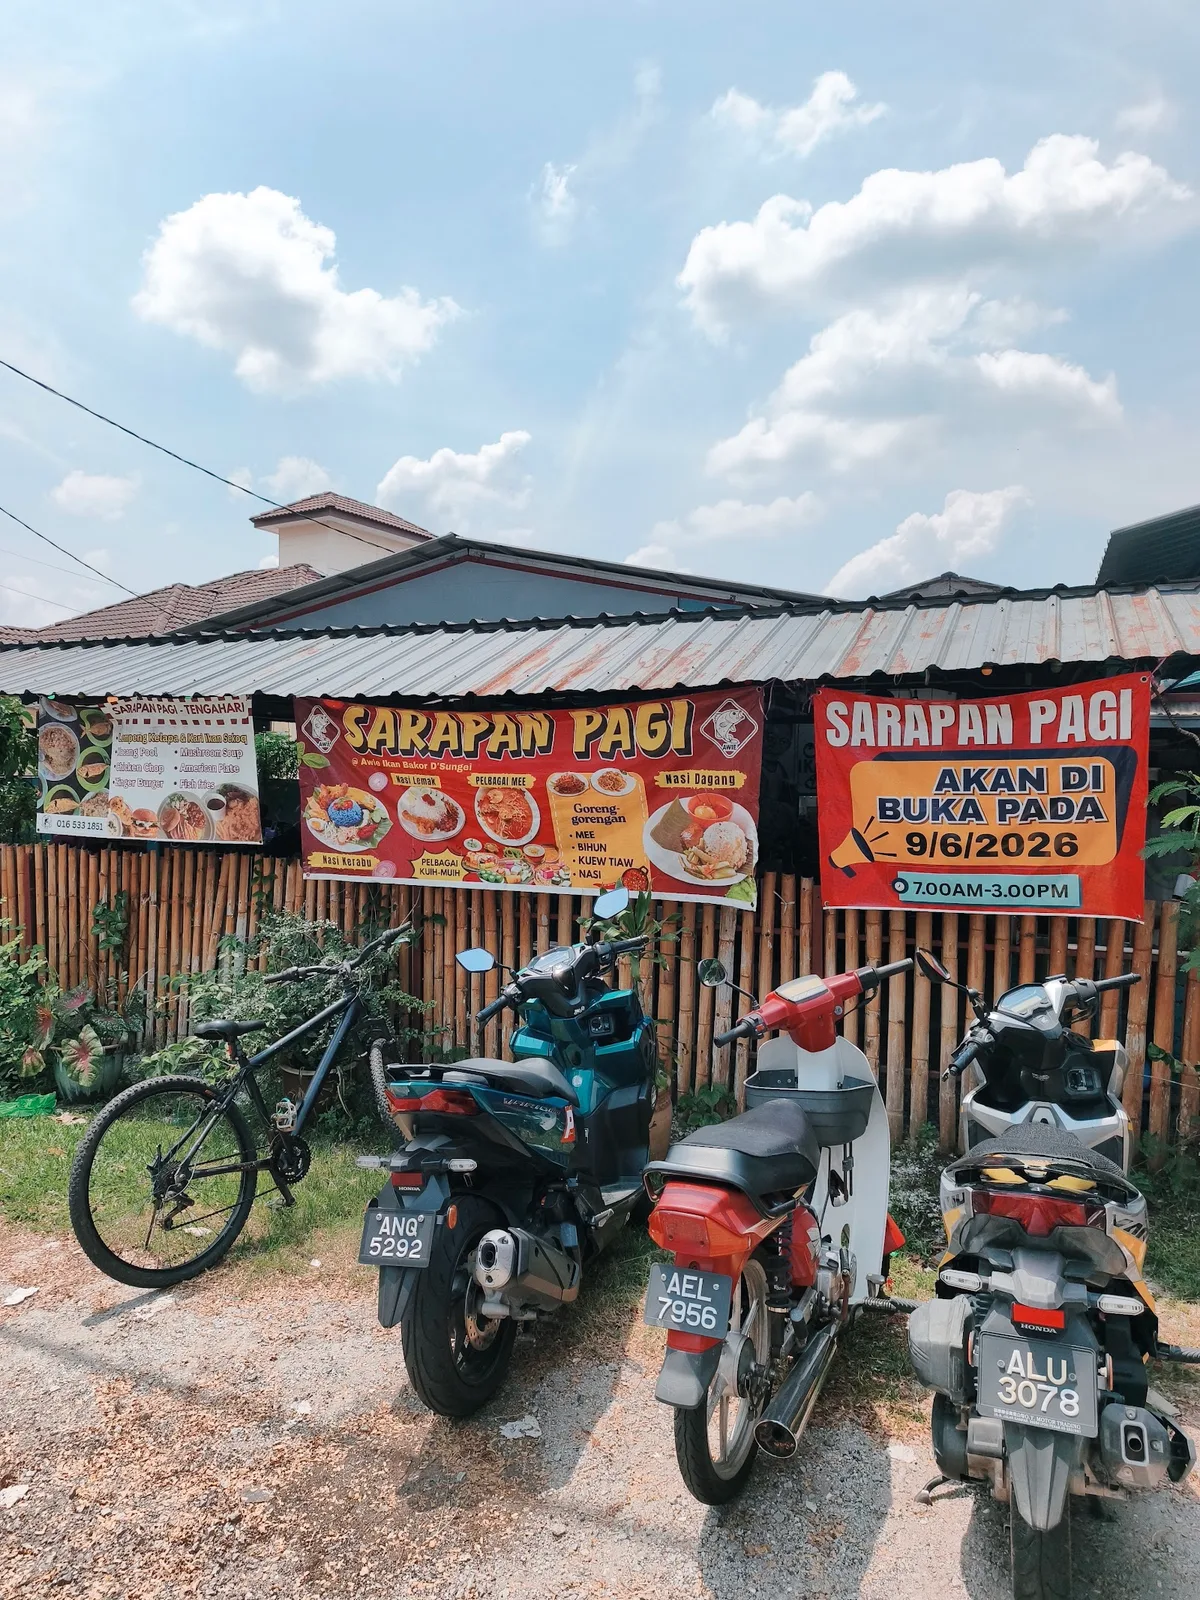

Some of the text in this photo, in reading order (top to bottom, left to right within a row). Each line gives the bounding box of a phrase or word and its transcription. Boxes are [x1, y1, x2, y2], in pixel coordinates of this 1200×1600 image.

[112, 702, 157, 715] SARAPAN
[157, 705, 178, 715] PAGI
[184, 702, 245, 715] TENGAHARI
[826, 688, 1132, 747] SARAPAN PAGI
[342, 699, 695, 761] SARAPAN PAGI
[148, 732, 179, 745] Kelapa
[180, 733, 187, 743] &
[187, 733, 204, 743] Kari
[139, 746, 158, 758] Pool
[180, 746, 243, 760] Mushroom Soup
[143, 762, 165, 774] Chop
[179, 763, 240, 774] American Plate
[351, 757, 359, 766] @
[360, 757, 381, 767] Awie
[382, 759, 401, 769] Ikan
[430, 762, 472, 773] D'Sungei
[137, 777, 165, 790] Burger
[179, 778, 215, 790] Fish fries
[395, 775, 437, 787] Nasi Lemak
[475, 776, 526, 786] PELBAGAI MEE
[665, 772, 736, 787] Nasi Dagang
[933, 764, 1106, 795] AKAN DI
[573, 803, 621, 815] Goreng-
[876, 796, 1109, 826] BUKA PADA
[56, 819, 103, 831] 016 533 1851
[571, 815, 627, 826] gorengan
[575, 830, 596, 839] MEE
[577, 842, 607, 853] BIHUN
[905, 831, 1079, 860] 9/6/2026
[322, 854, 372, 868] Nasi Kerabu
[421, 858, 459, 867] PELBAGAI
[578, 855, 634, 868] KUEW TIAW
[419, 867, 461, 877] KUIH-MUIH
[579, 869, 602, 879] NASI
[912, 881, 1069, 899] 7.00AM-3.00PM
[378, 1216, 418, 1237] ANQ
[369, 1237, 423, 1259] 5292
[666, 1272, 711, 1302] AEL
[658, 1296, 718, 1330] 7956
[1020, 1323, 1057, 1334] HONDA
[1006, 1349, 1067, 1386] ALU
[997, 1376, 1080, 1417] 3078
